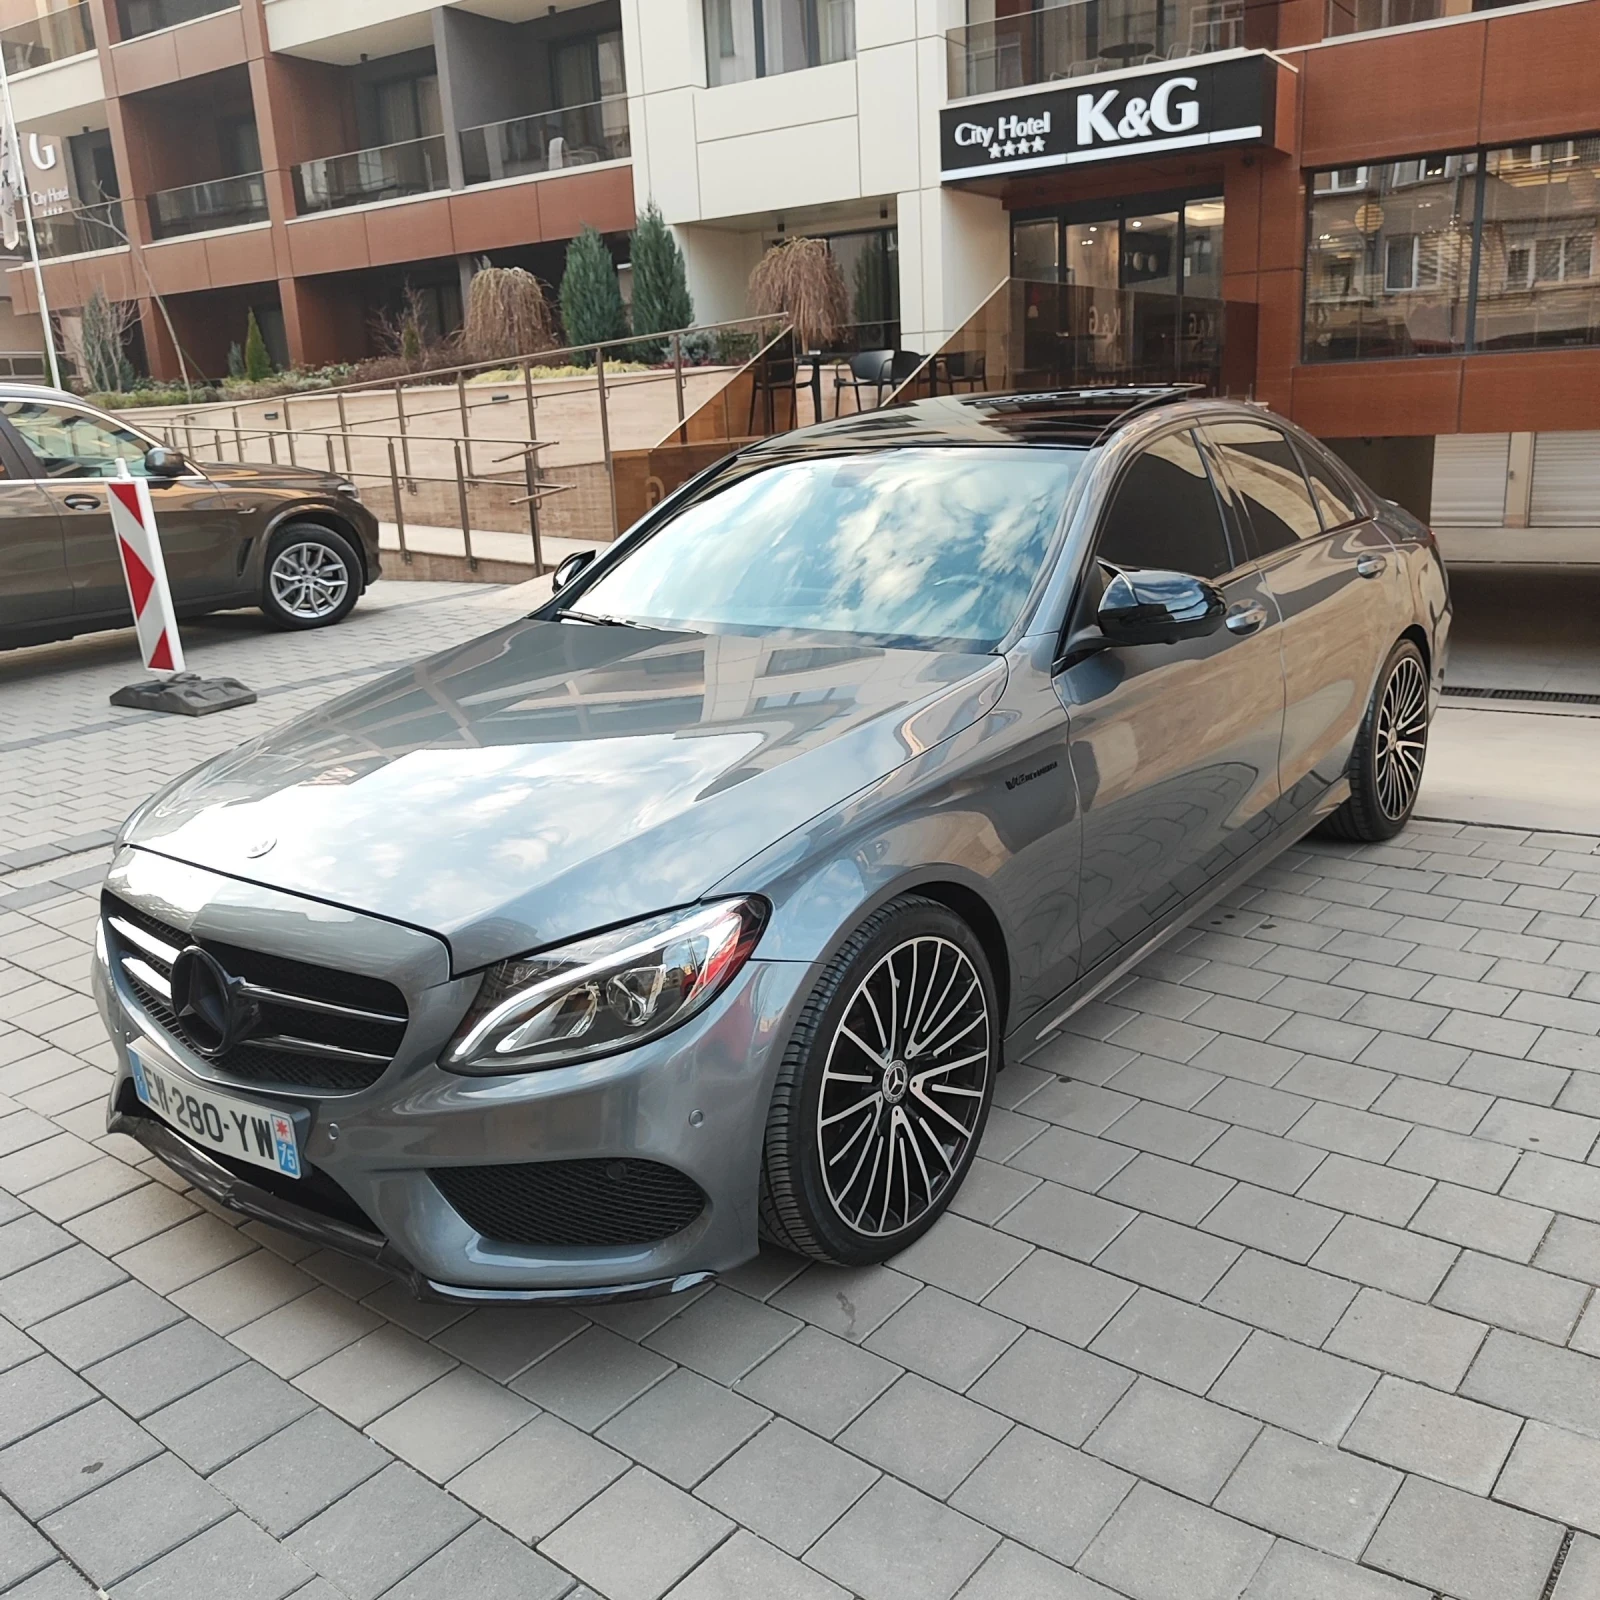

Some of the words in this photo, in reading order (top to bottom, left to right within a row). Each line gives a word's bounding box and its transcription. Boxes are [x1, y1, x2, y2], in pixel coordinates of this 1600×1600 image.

[954, 122, 995, 148] City
[998, 111, 1051, 140] Hotel
[1076, 77, 1200, 145] K&G
[279, 1143, 296, 1170] 75
